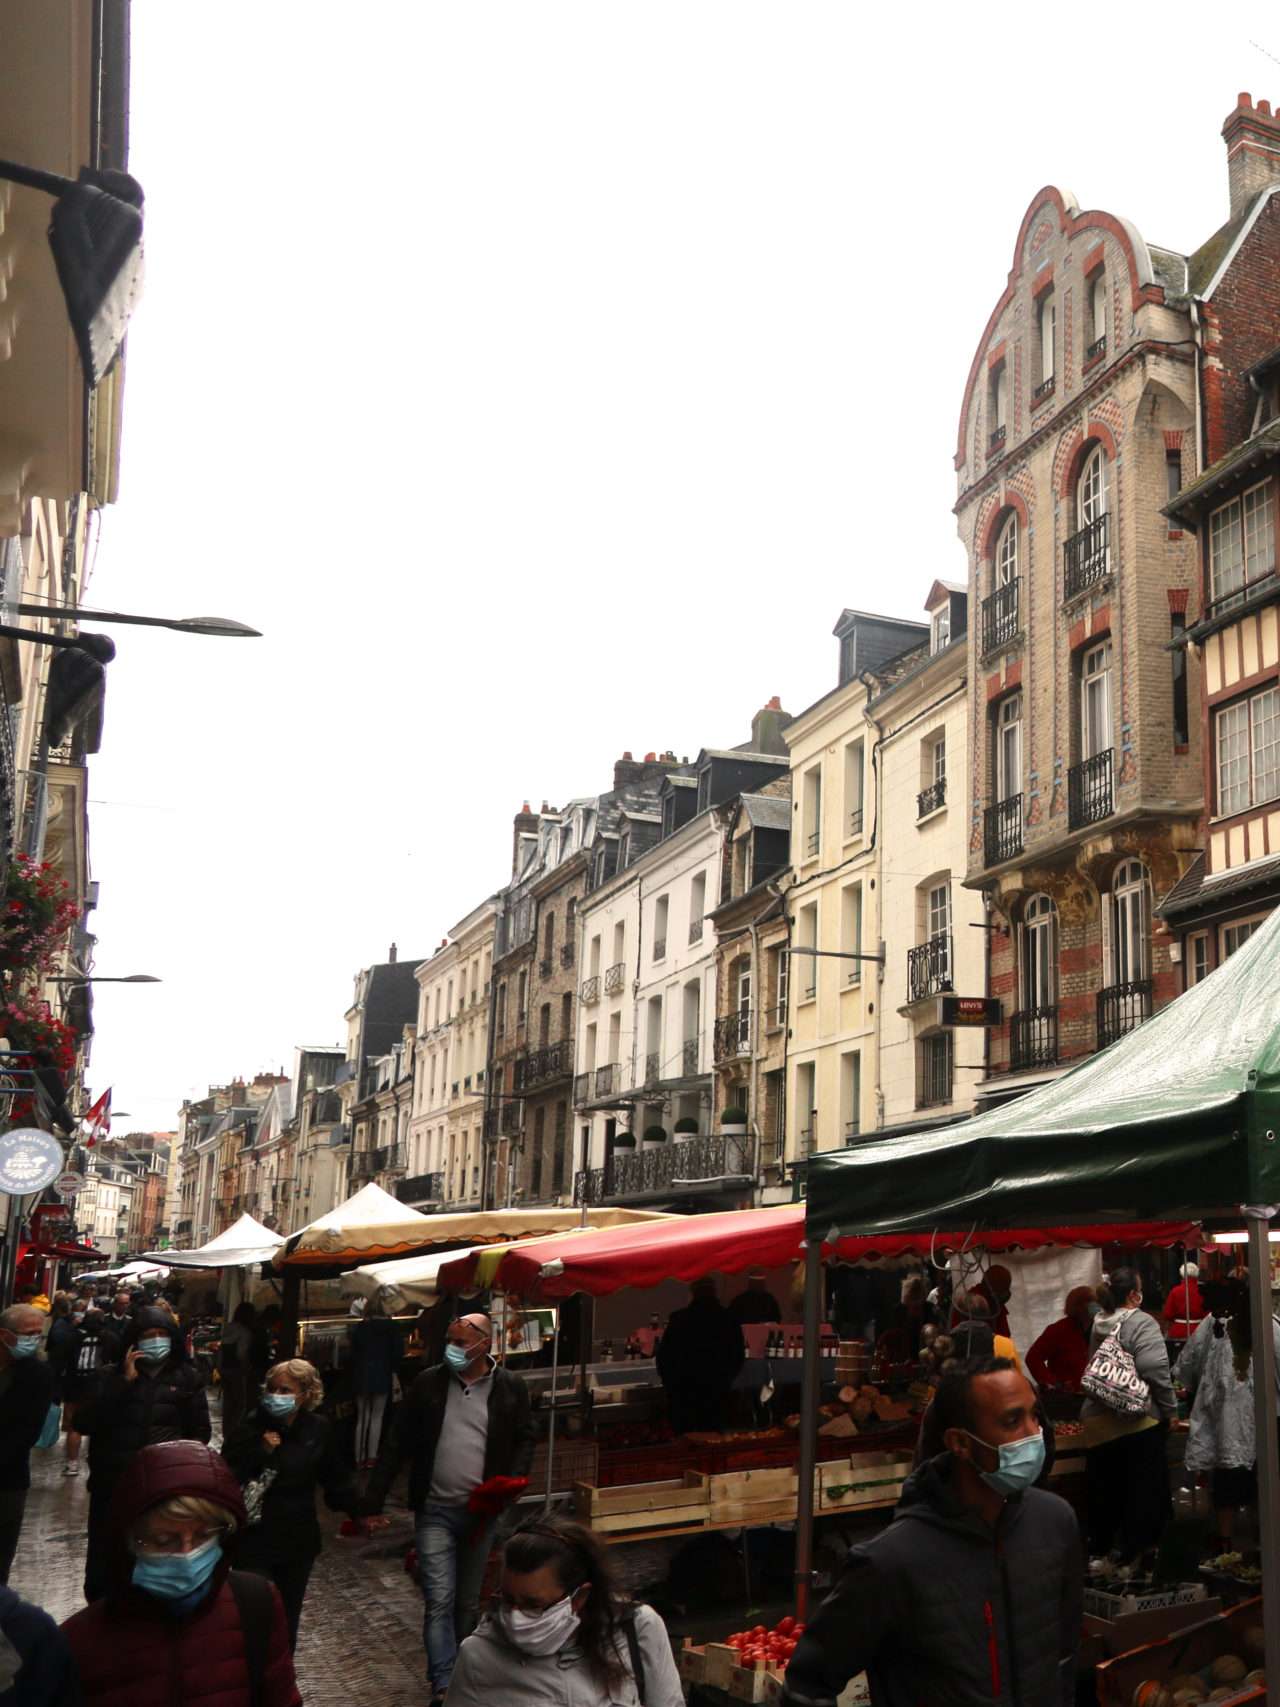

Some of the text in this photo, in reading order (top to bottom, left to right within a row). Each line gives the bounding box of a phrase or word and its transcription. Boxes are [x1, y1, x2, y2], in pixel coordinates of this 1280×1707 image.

[4, 1135, 50, 1149] La Maison
[1089, 1357, 1149, 1397] LONDON
